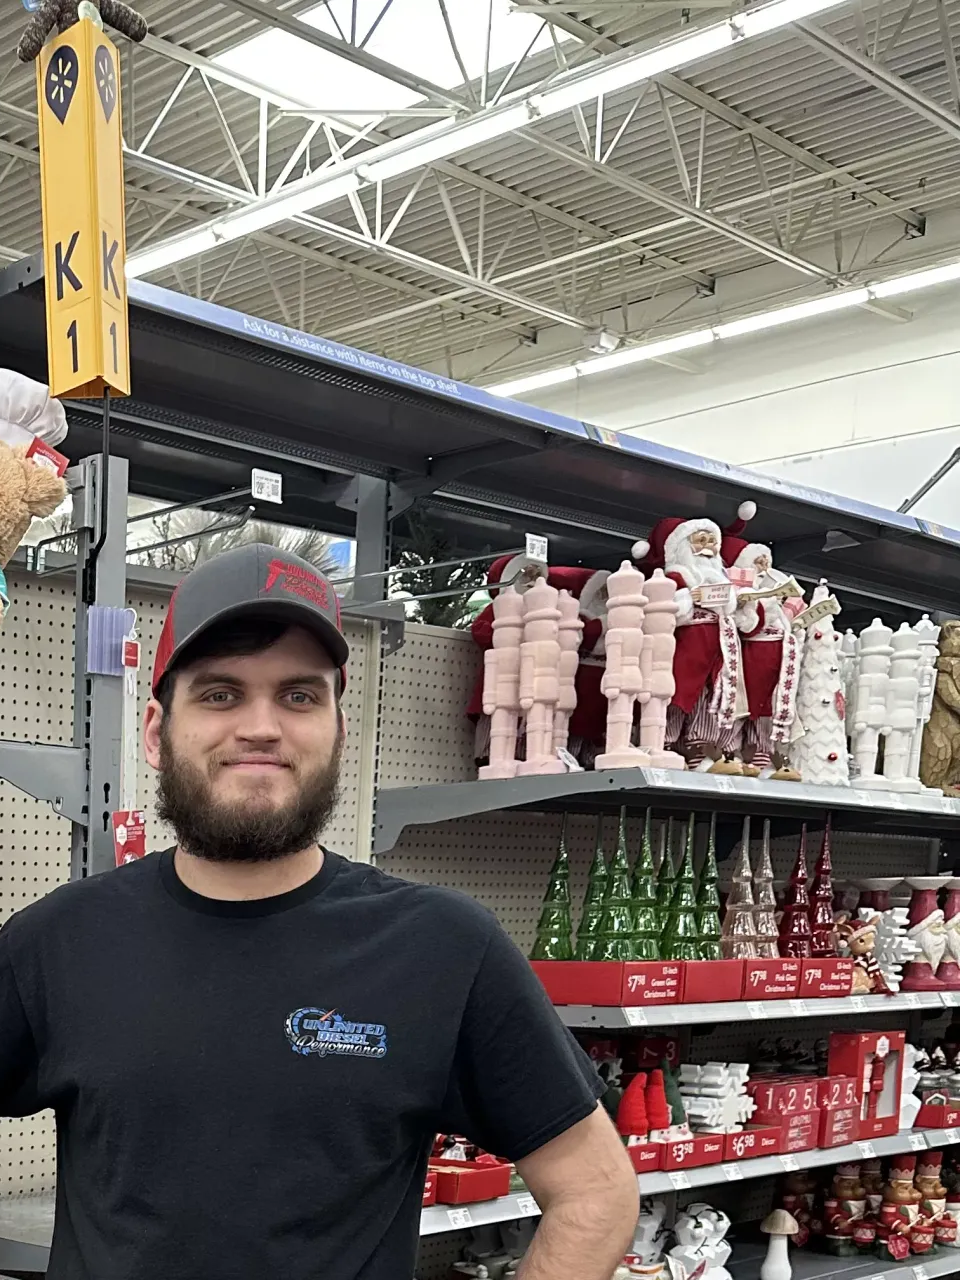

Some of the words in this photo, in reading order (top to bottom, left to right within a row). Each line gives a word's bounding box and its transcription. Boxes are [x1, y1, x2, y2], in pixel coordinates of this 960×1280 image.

[55, 231, 83, 302] K
[102, 230, 121, 300] K
[67, 319, 79, 374] 1
[109, 321, 118, 375] 1
[243, 318, 262, 334] Ask
[264, 324, 280, 339] for
[335, 348, 359, 363] with
[359, 354, 387, 372] items
[388, 364, 402, 377] on
[401, 366, 418, 382] the
[418, 373, 436, 388] top
[303, 1019, 385, 1036] UNLIMITED
[316, 1031, 369, 1046] DIESEL
[296, 1035, 386, 1057] Performance
[704, 1143, 720, 1152] Décor
[761, 1137, 776, 1146] Décor
[640, 1151, 657, 1160] Décor
